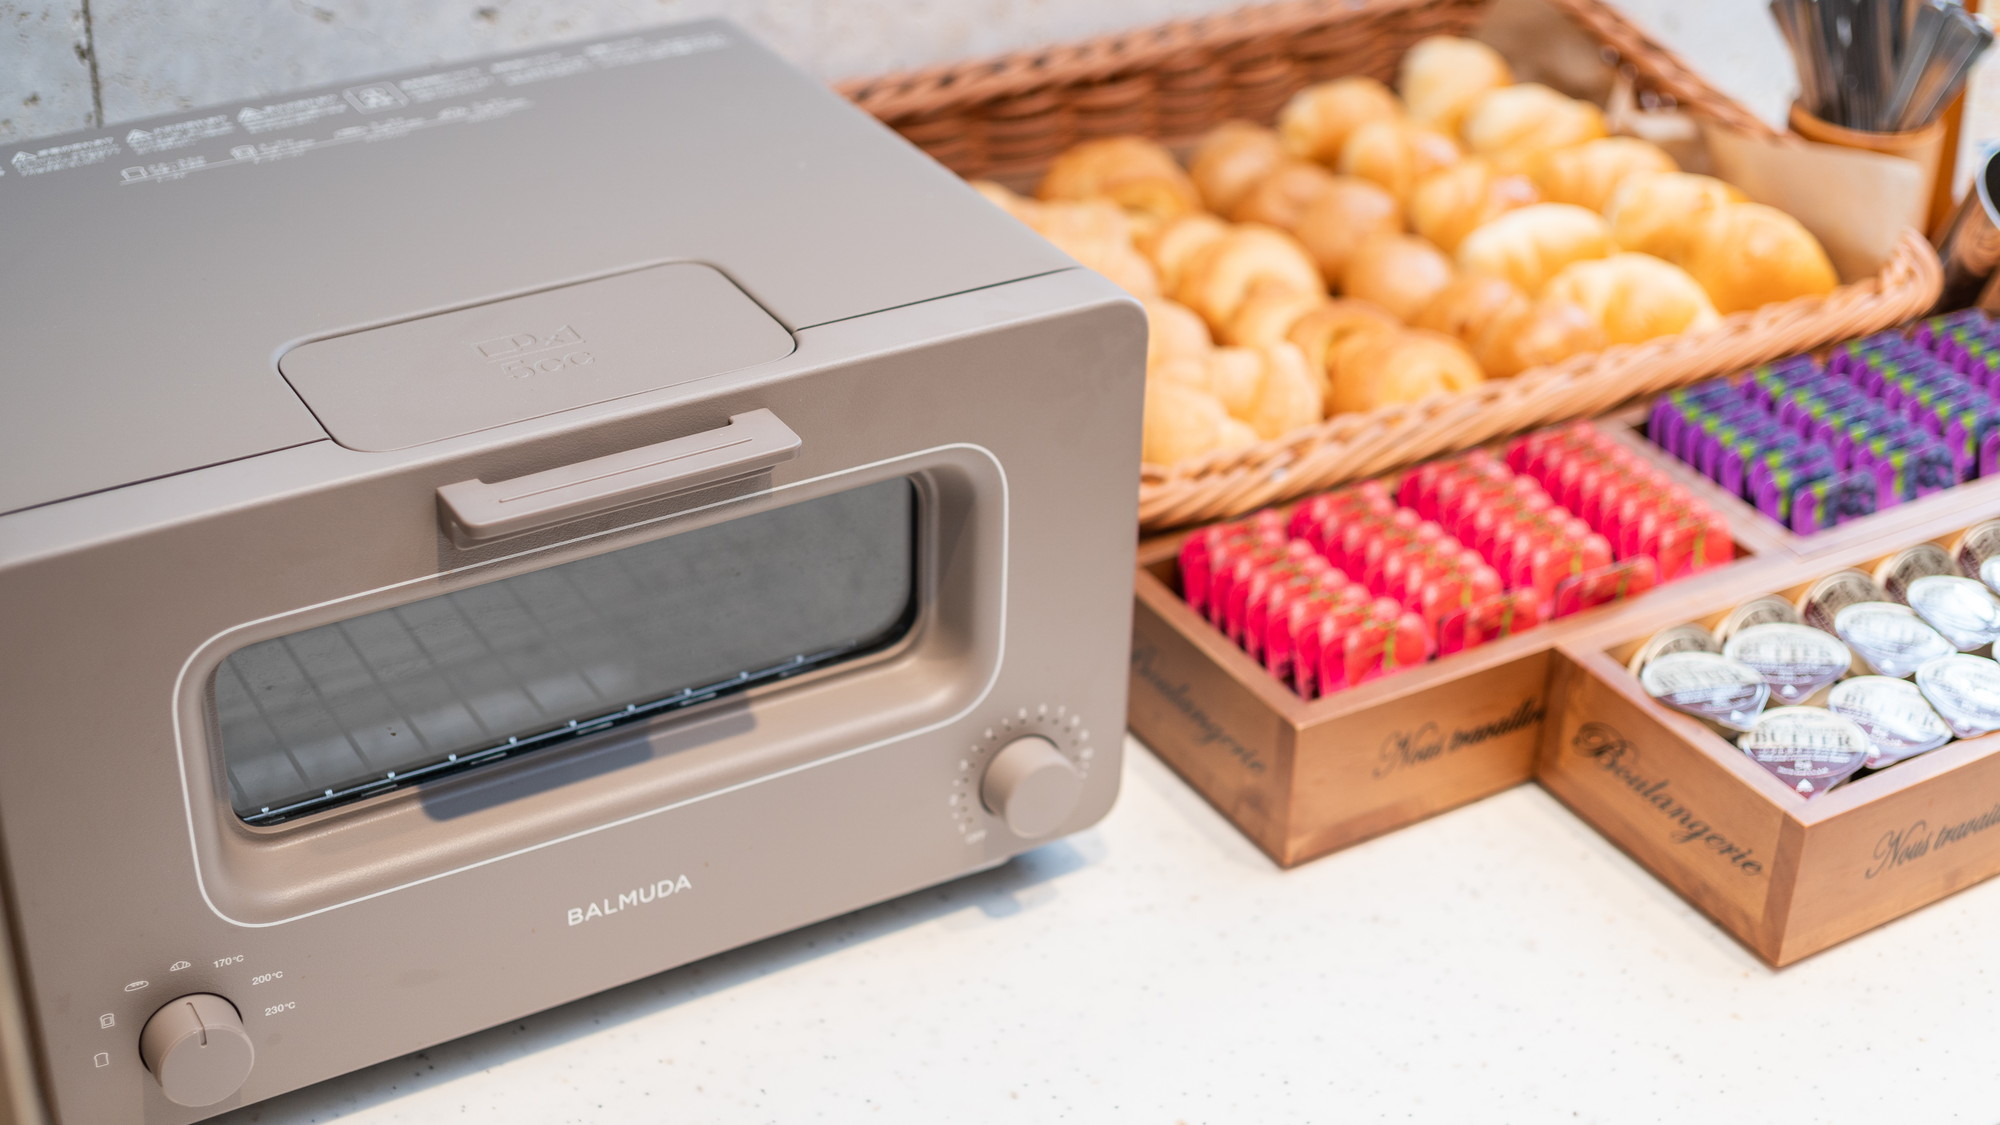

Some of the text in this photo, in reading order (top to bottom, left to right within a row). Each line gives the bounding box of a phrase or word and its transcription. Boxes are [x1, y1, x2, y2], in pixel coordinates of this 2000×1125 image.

[1572, 721, 1763, 875] Boulangerie
[1864, 819, 1933, 880] Nous
[567, 874, 692, 926] BALMUDA
[213, 954, 244, 968] 170°C
[252, 970, 283, 985] 200°C
[265, 1001, 296, 1016] 230°C
